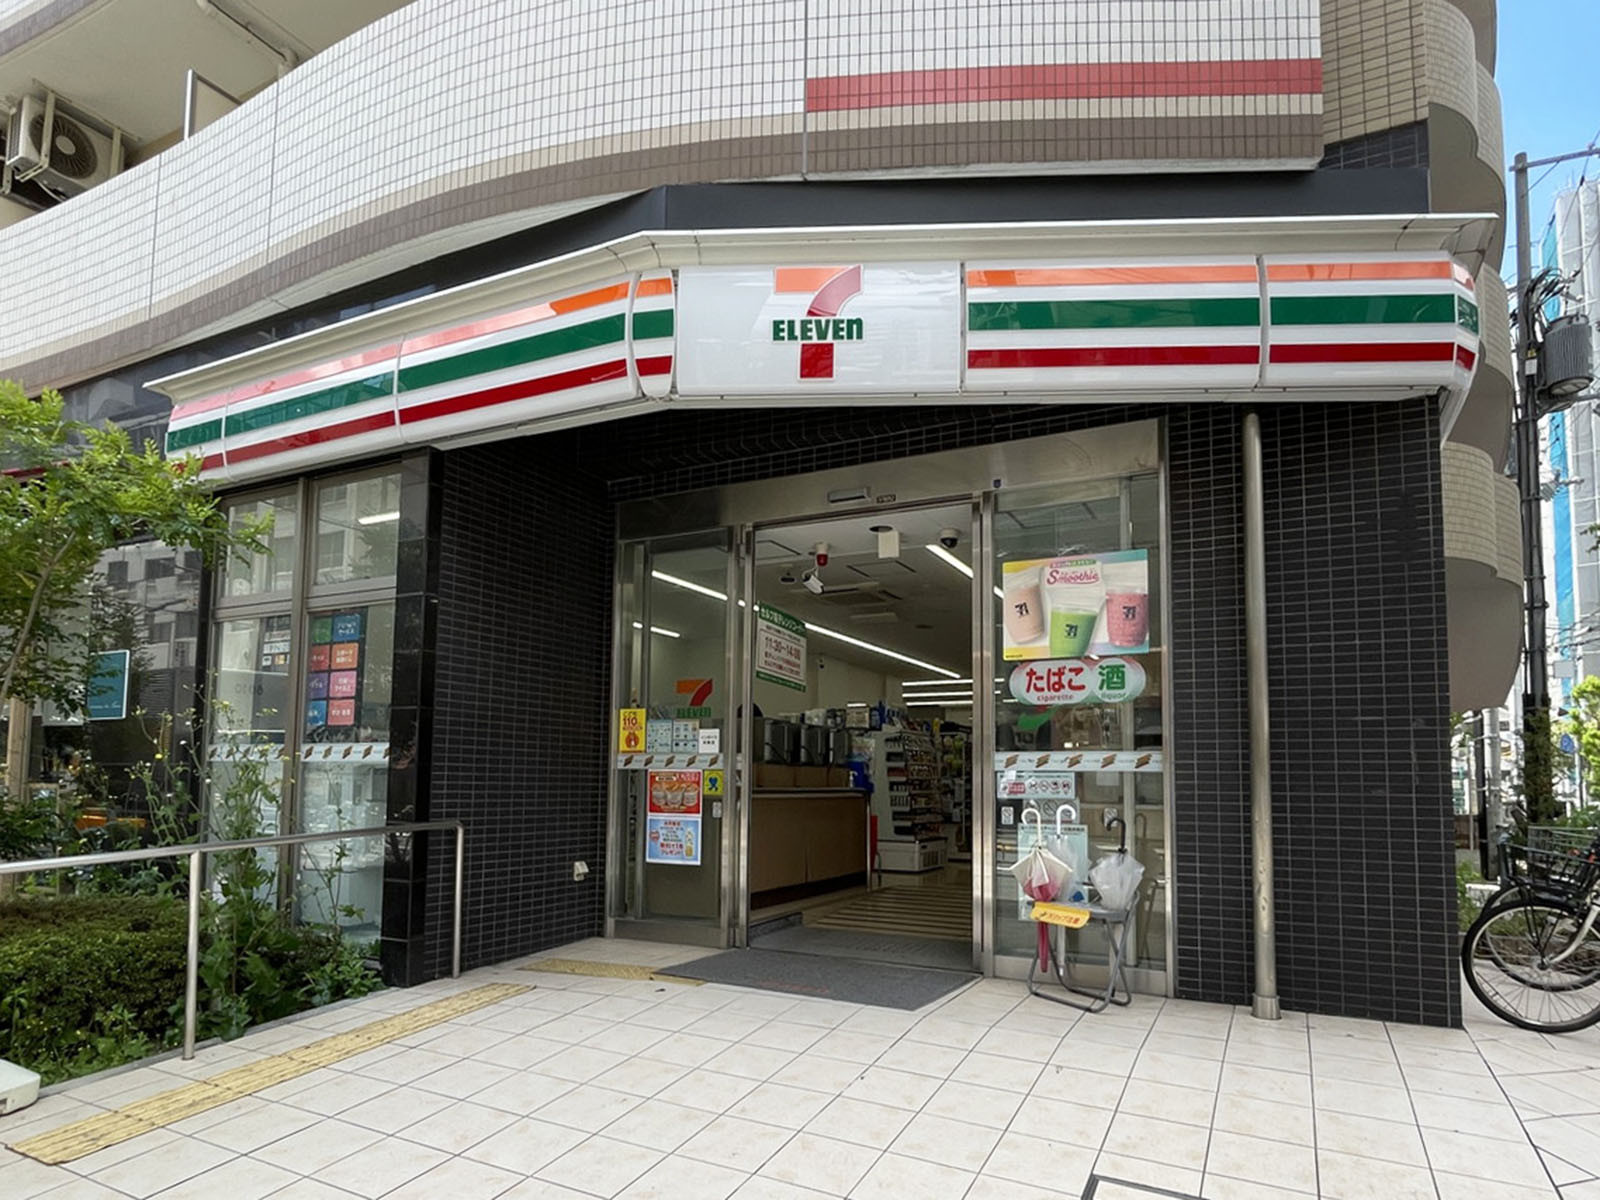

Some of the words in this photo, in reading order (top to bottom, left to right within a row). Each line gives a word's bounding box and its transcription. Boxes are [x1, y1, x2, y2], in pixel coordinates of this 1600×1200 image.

[775, 265, 861, 379] 7
[1047, 569, 1099, 585] Smoothie
[1026, 665, 1086, 693] たばこ
[1098, 664, 1126, 691] 酒
[1037, 693, 1074, 702] cigarette
[623, 717, 638, 726] 110
